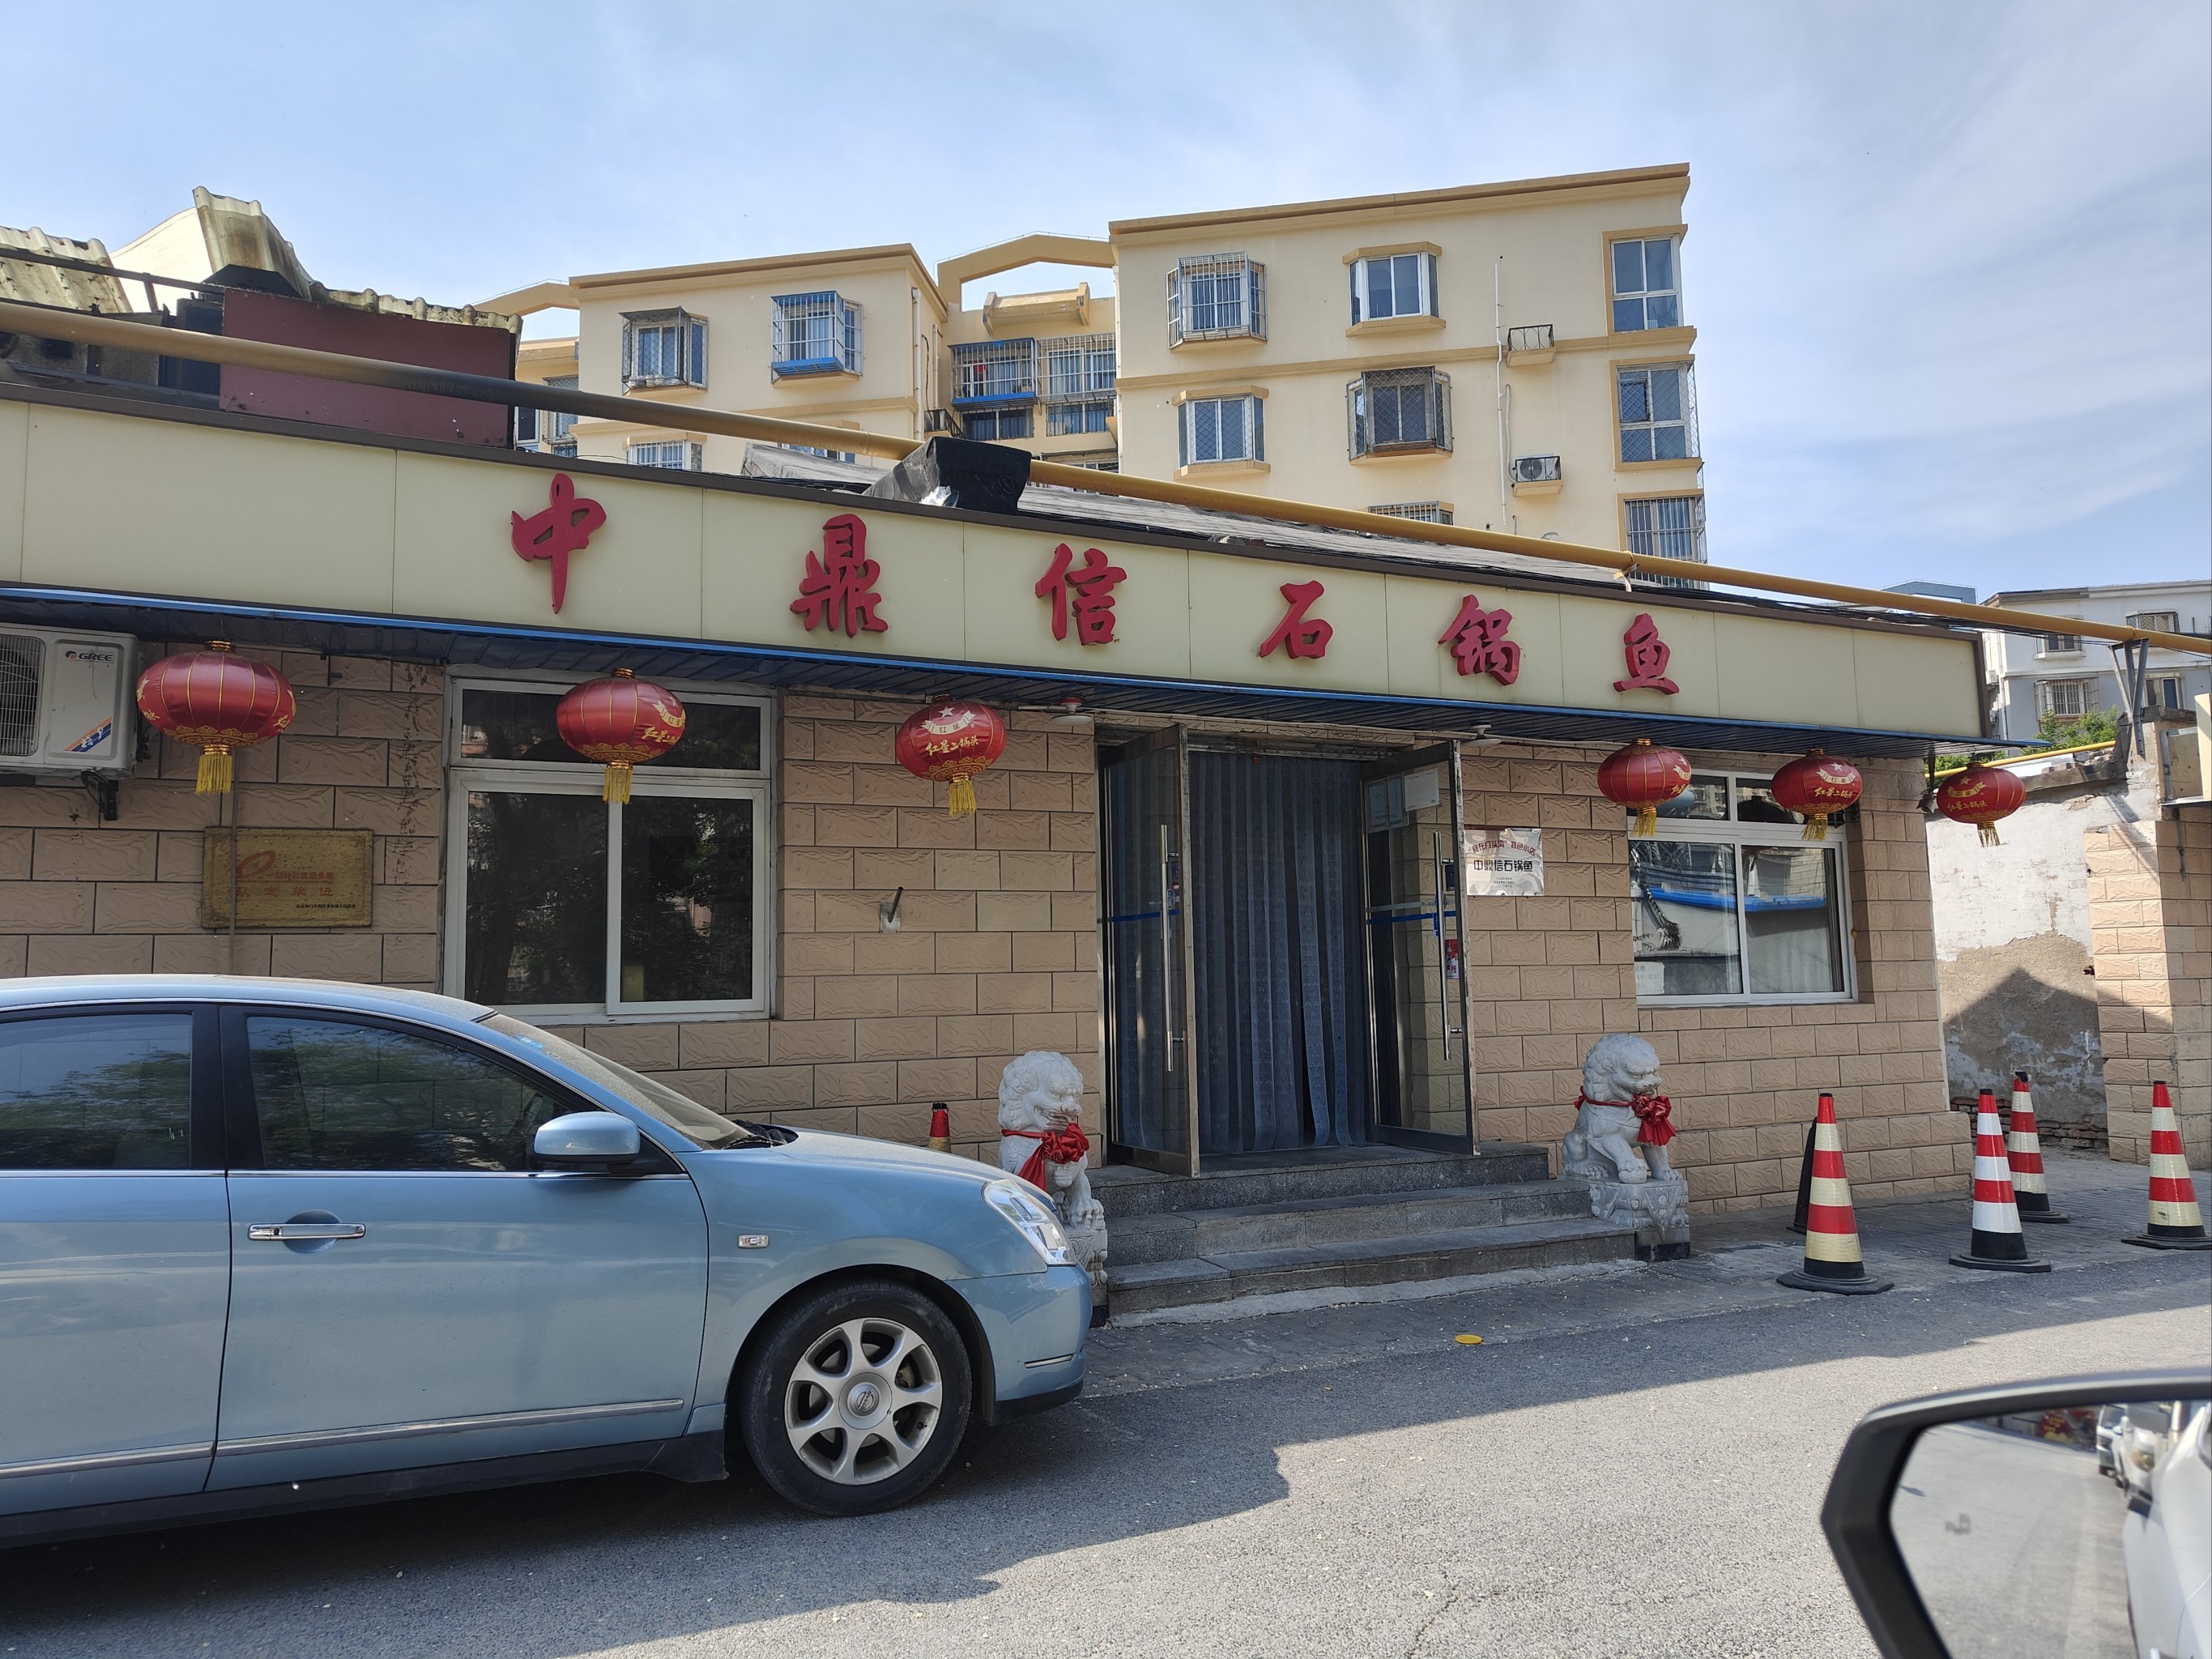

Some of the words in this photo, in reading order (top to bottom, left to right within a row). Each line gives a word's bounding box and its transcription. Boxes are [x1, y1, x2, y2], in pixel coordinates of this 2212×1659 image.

[511, 472, 1679, 696] 中鼎信石锅鱼
[79, 653, 113, 662] GREE
[925, 735, 979, 757] 红星二锅头
[1814, 787, 1853, 798] 红星二锅头
[1947, 800, 1988, 812] 红星二锅头
[1511, 841, 1536, 856] 特色小店
[1473, 859, 1533, 872] 中鼎信石锅鱼
